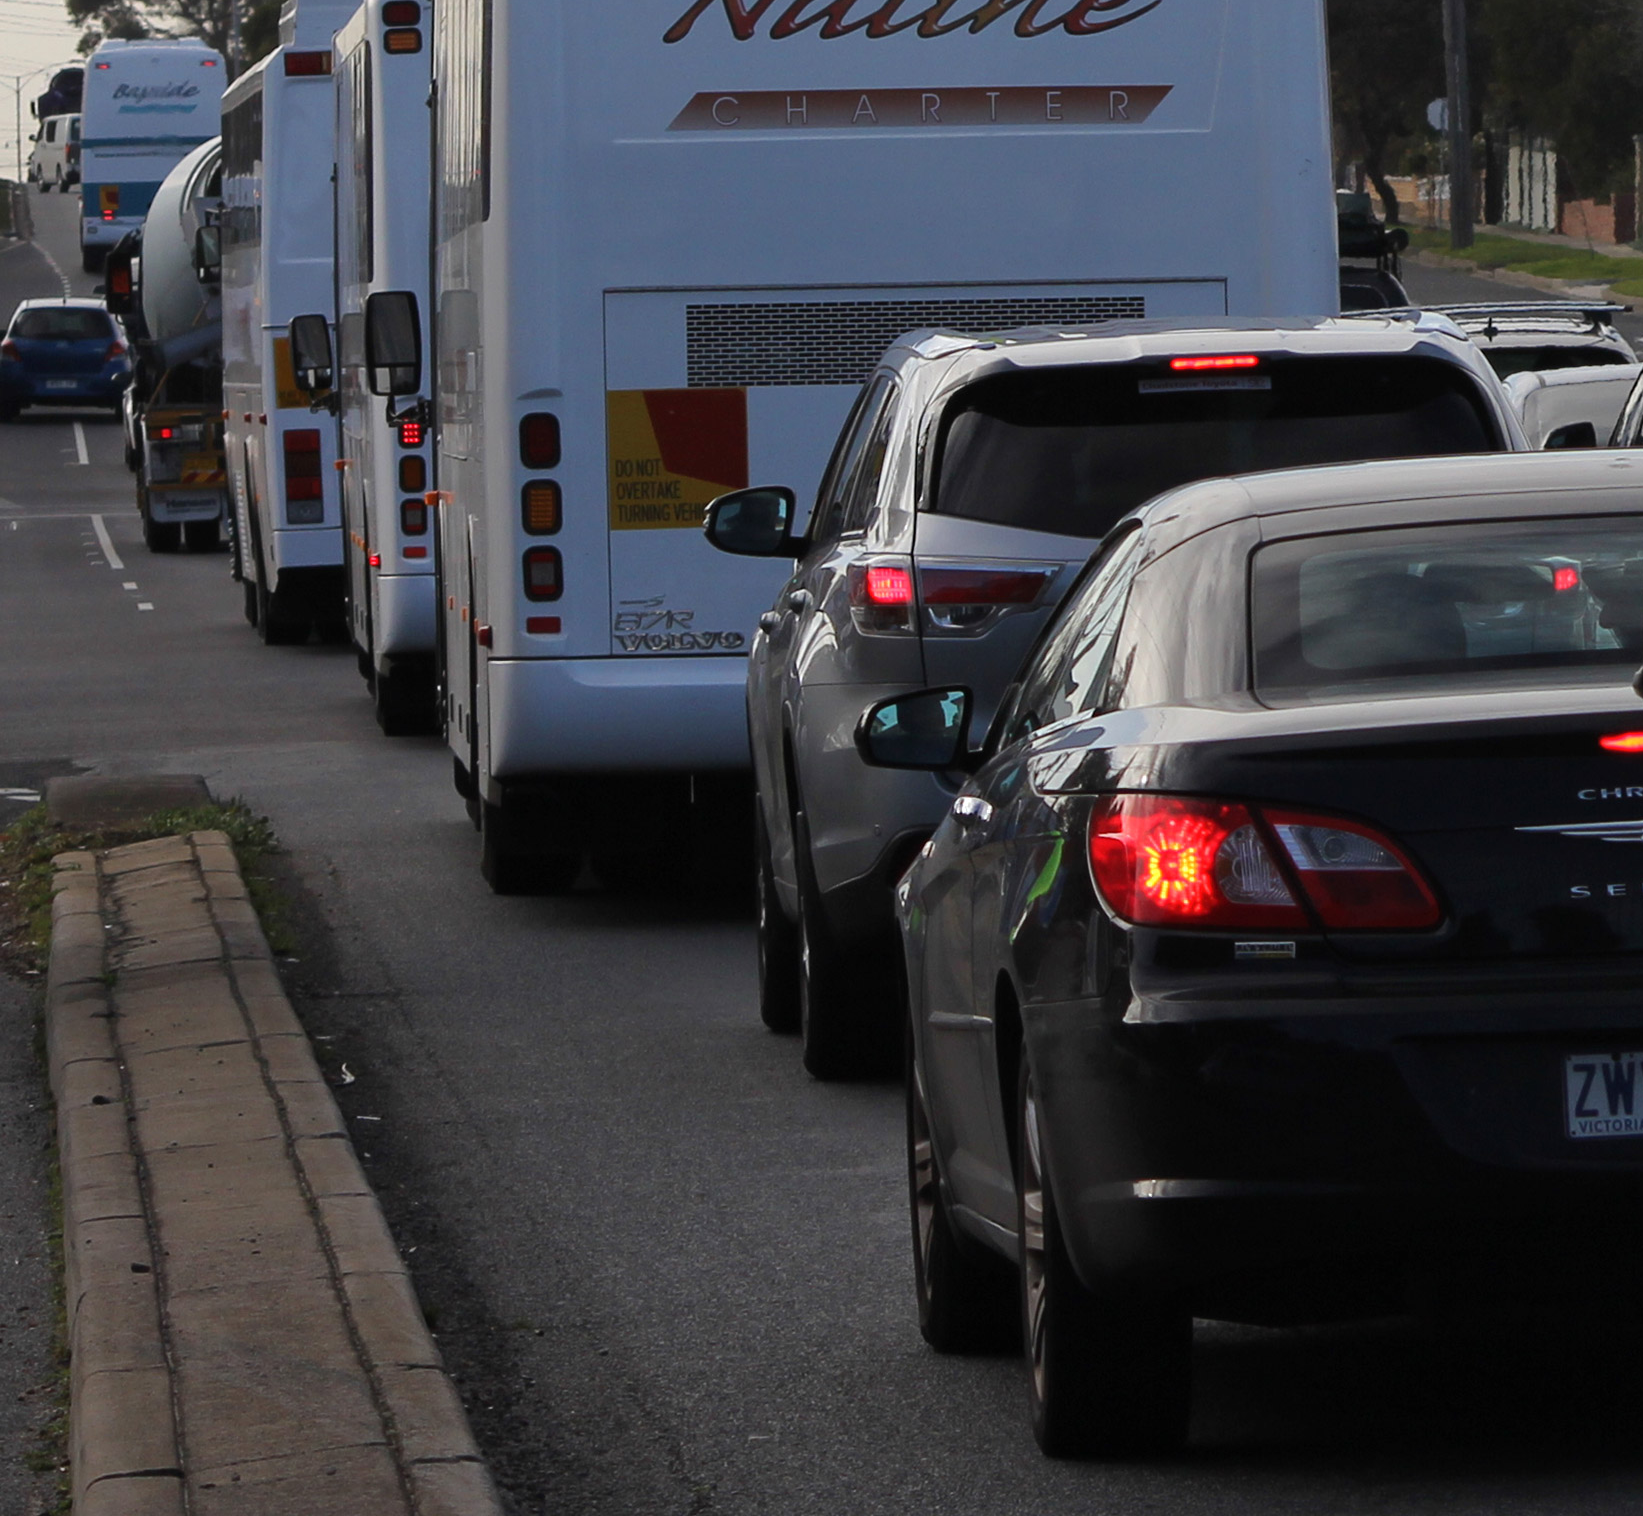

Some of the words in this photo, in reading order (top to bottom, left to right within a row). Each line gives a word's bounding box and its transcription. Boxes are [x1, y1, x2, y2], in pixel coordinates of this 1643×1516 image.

[711, 90, 1130, 127] CHARTER
[615, 459, 633, 478] DO
[636, 458, 661, 477] NOT
[616, 480, 681, 500] OVERTAKE
[617, 503, 671, 522] TURNING
[614, 632, 745, 652] VOLVO
